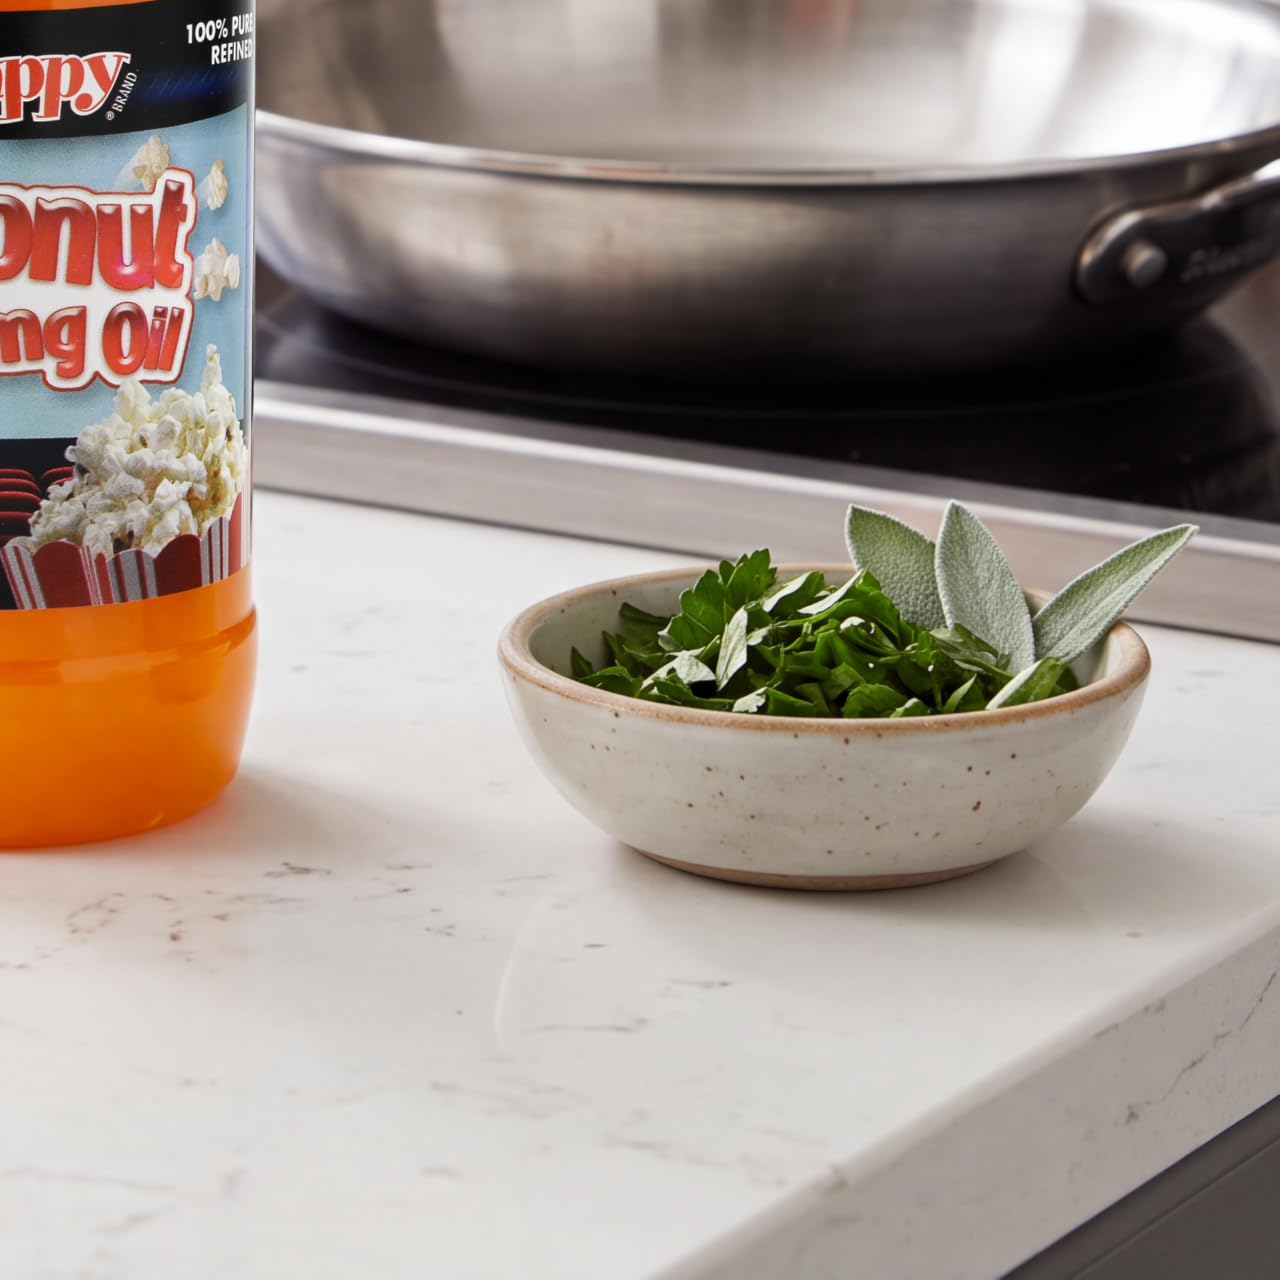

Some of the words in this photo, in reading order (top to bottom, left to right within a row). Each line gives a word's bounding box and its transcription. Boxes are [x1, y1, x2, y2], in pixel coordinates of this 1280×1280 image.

[186, 18, 228, 44] 100%
[232, 12, 253, 37] PURE
[211, 38, 253, 65] REFINED
[111, 72, 137, 112] BRAND
[100, 299, 187, 376] Oil
